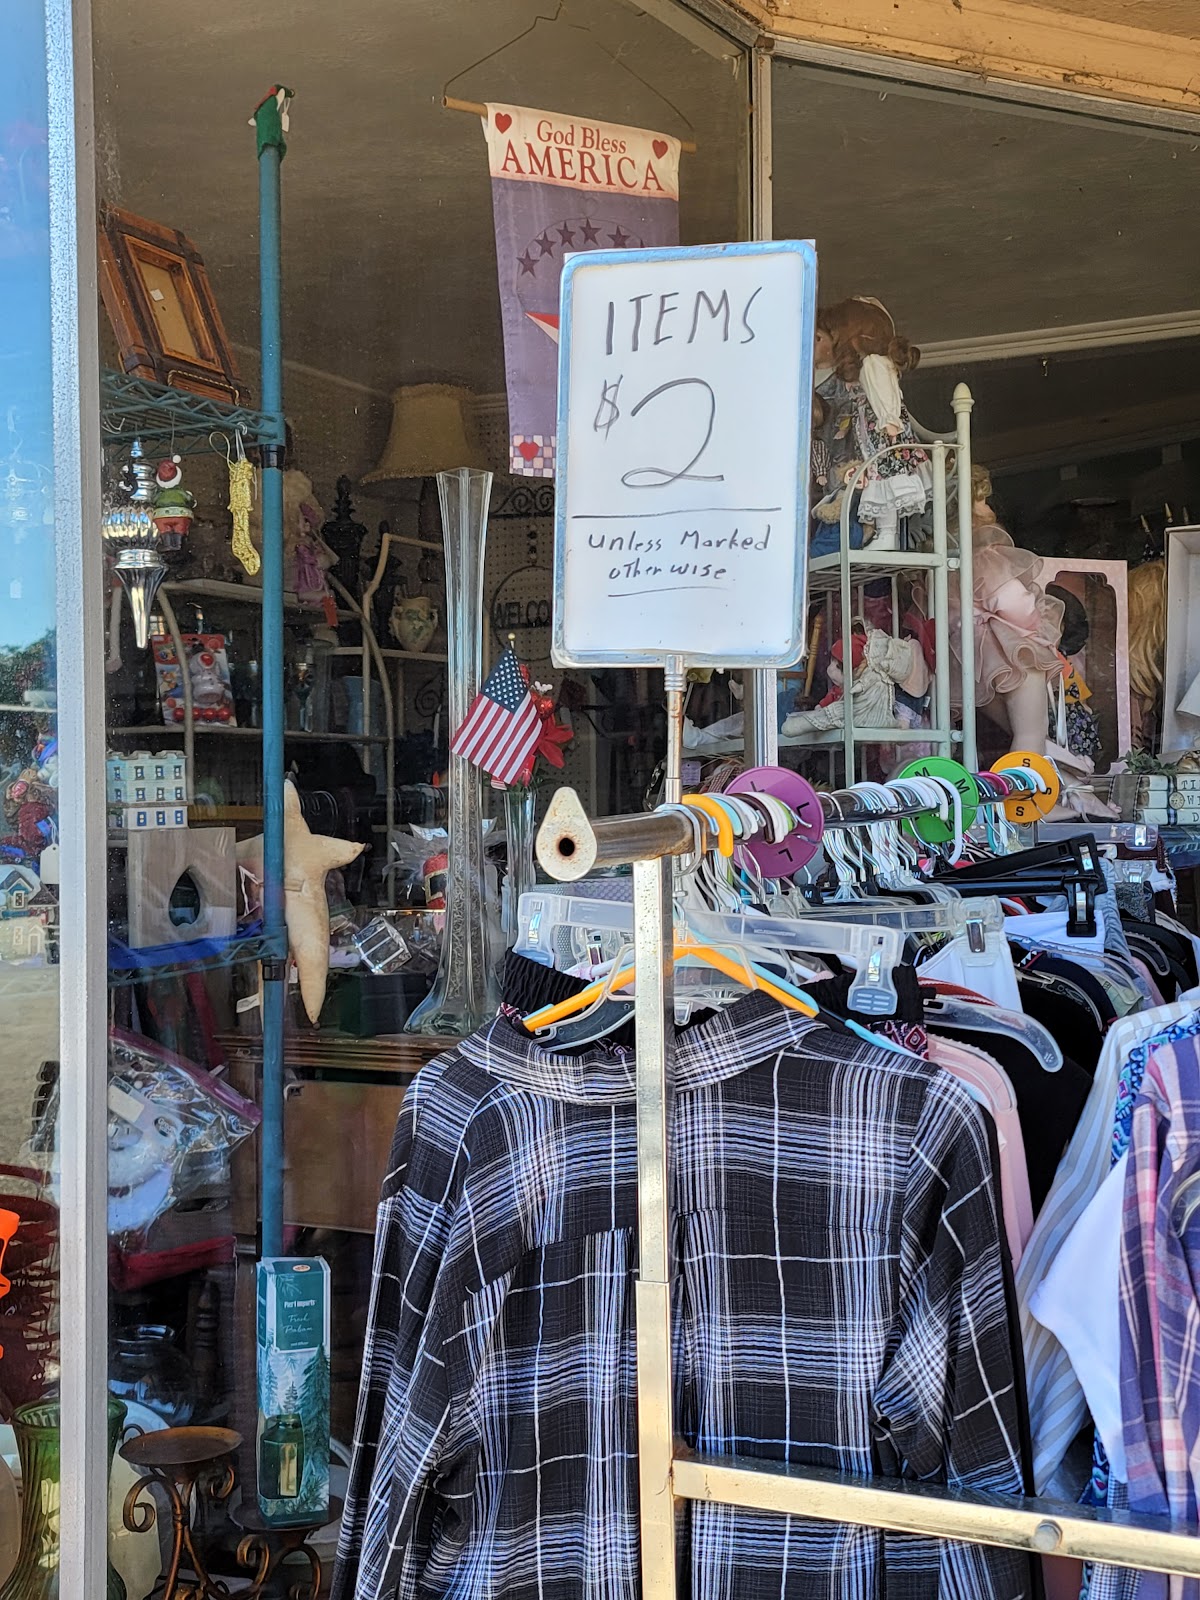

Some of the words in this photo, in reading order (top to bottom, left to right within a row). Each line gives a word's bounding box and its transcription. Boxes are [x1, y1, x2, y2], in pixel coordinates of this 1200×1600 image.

[537, 120, 575, 146] God
[580, 126, 627, 154] Bless
[501, 139, 665, 191] AMERICA
[605, 286, 763, 355] ITEMS
[680, 524, 771, 551] Marked
[1022, 758, 1031, 767] S
[954, 778, 970, 794] M
[796, 801, 810, 818] L
[1015, 806, 1025, 817] S
[778, 847, 794, 863] L
[804, 890, 813, 899] M
